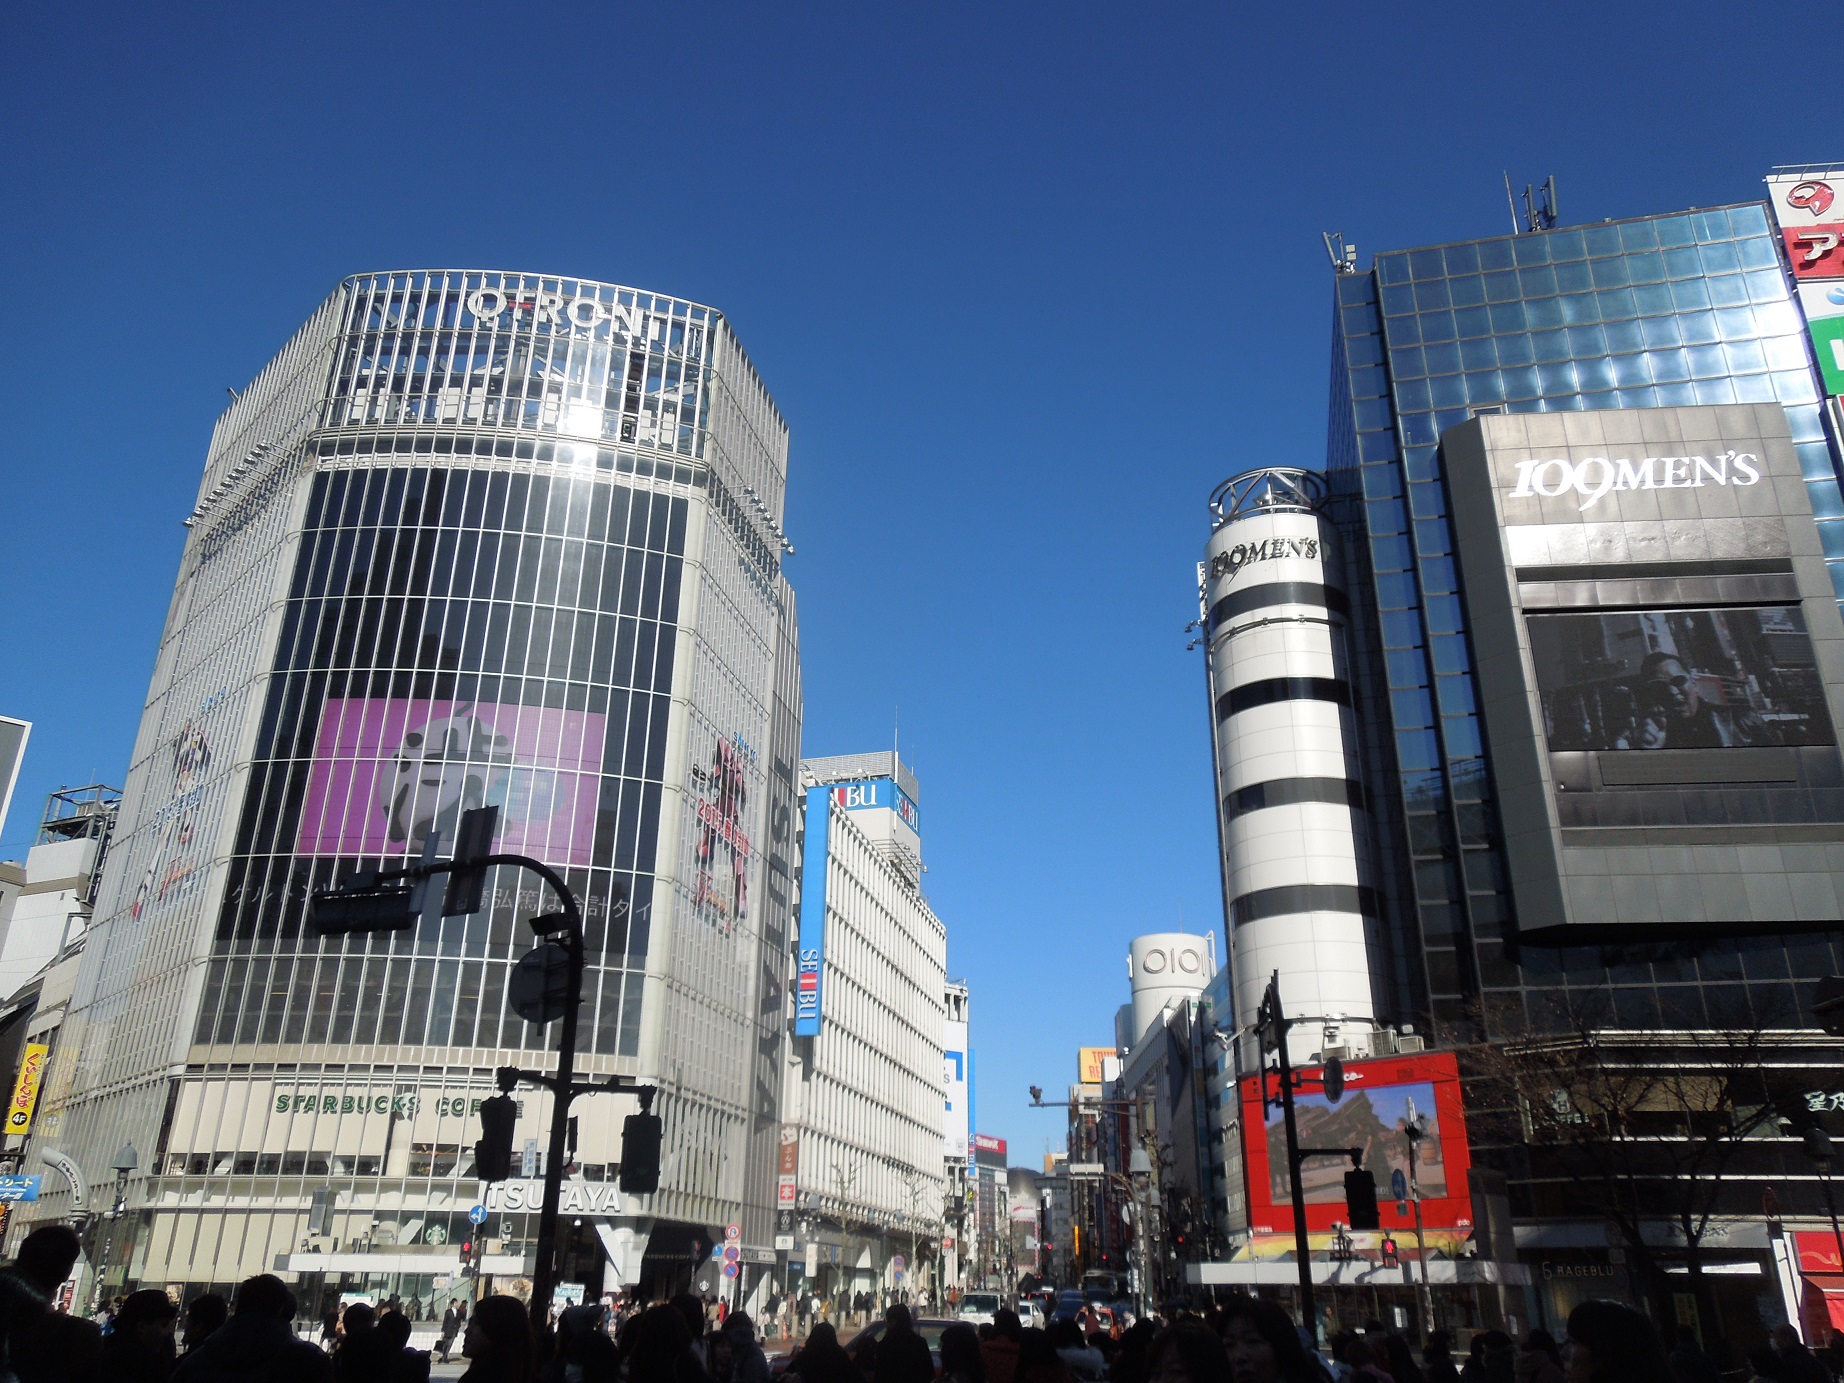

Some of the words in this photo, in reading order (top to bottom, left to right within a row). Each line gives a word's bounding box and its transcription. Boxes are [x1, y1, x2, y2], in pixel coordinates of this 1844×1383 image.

[12, 1113, 26, 1123] 4F
[276, 1094, 420, 1120] STARBUCKS
[488, 1183, 621, 1212] TSUAYA
